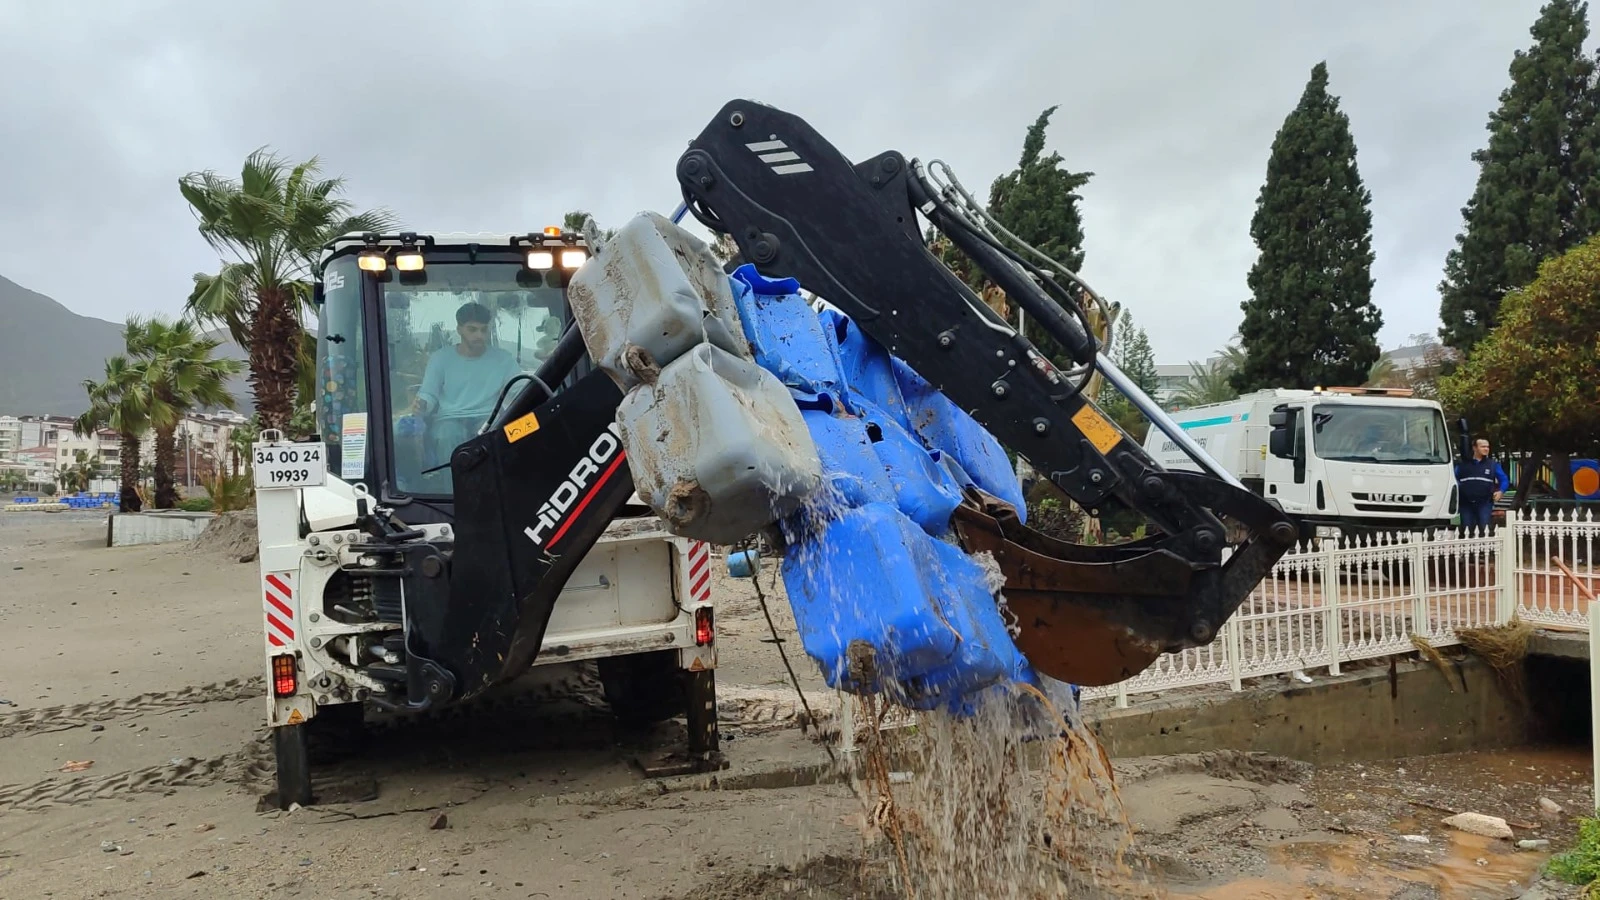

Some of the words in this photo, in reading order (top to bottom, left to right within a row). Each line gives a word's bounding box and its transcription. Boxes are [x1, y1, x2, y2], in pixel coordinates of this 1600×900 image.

[256, 451, 275, 464] 34
[279, 450, 299, 464] 00
[303, 449, 320, 462] 24
[270, 469, 309, 483] 19939
[1367, 492, 1414, 503] IVECO
